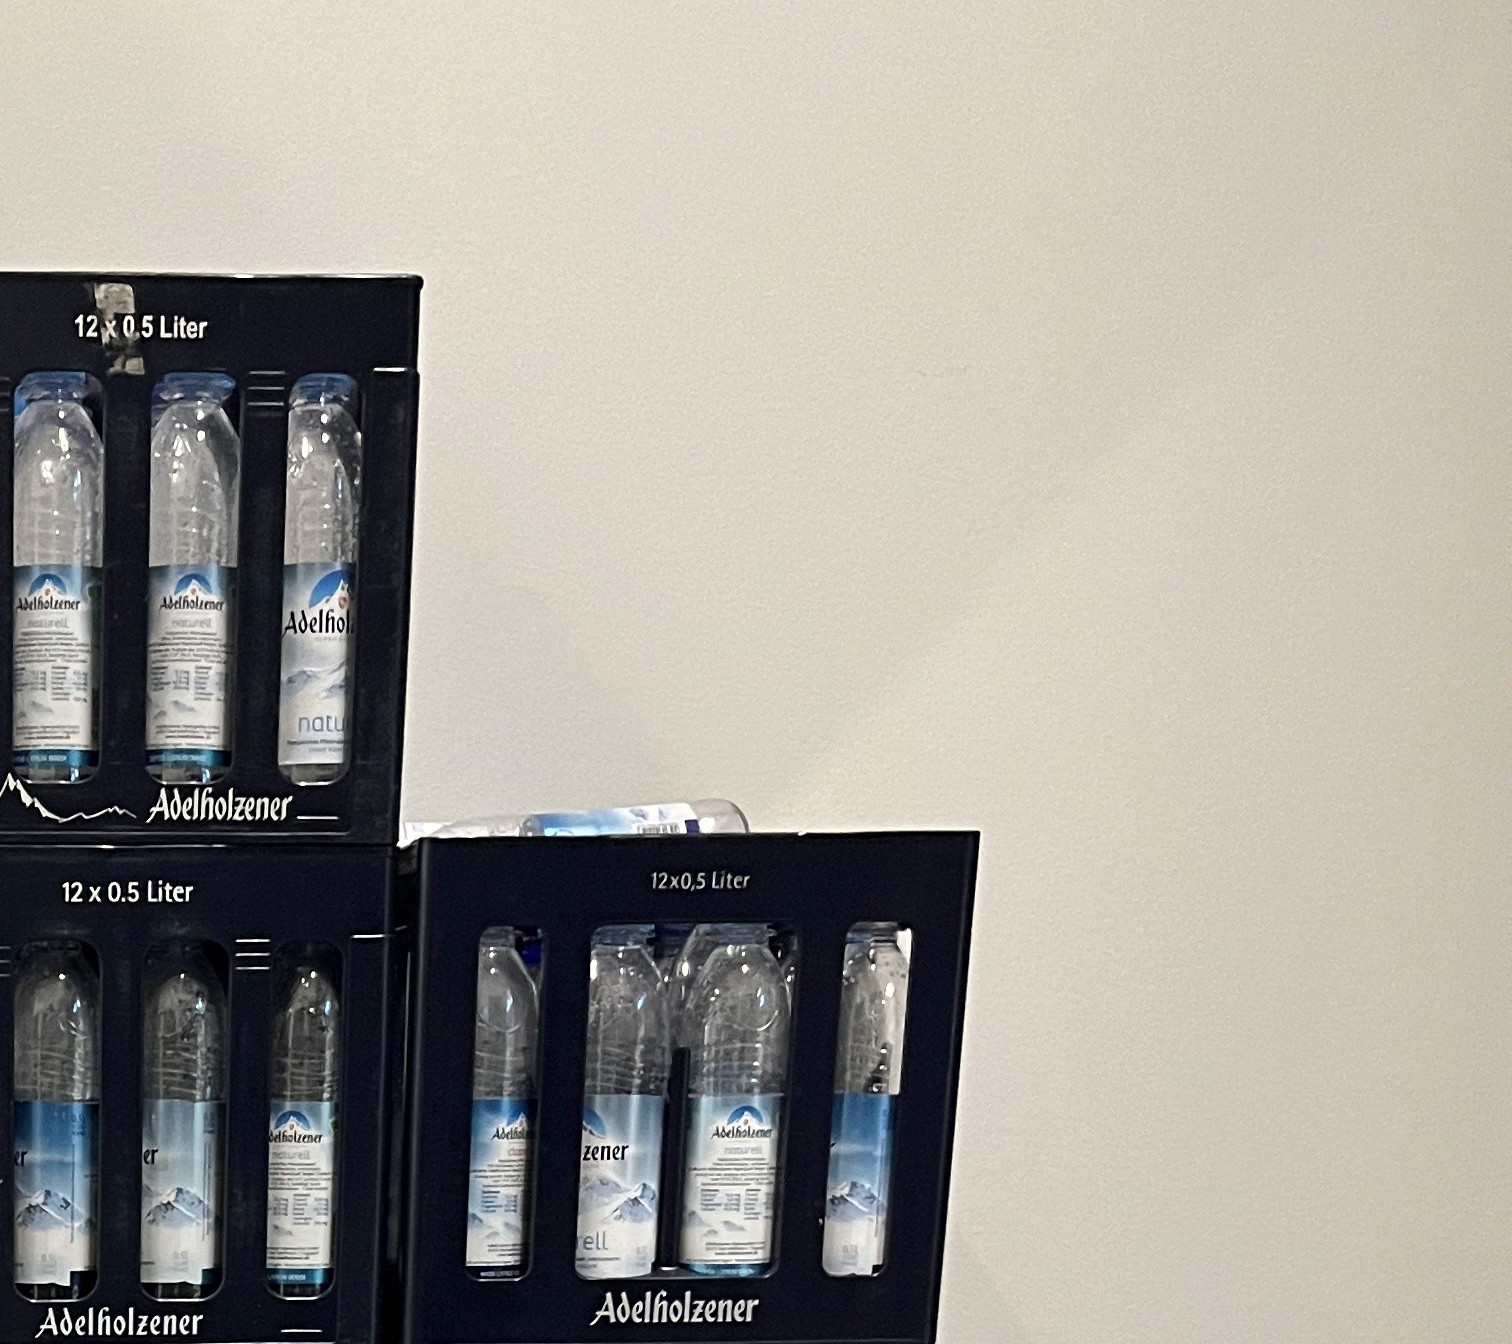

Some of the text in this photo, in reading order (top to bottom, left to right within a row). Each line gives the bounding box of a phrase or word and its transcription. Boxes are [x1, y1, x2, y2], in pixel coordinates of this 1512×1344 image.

[75, 315, 207, 340] 12 x 0.5 Liter
[284, 609, 352, 637] Adelhol
[146, 787, 293, 823] Adelholzener
[62, 881, 194, 904] 12 x 0.5 Liter
[711, 870, 750, 890] Liter
[590, 1290, 760, 1326] Adelholzener
[35, 1307, 205, 1338] Adelholzener
